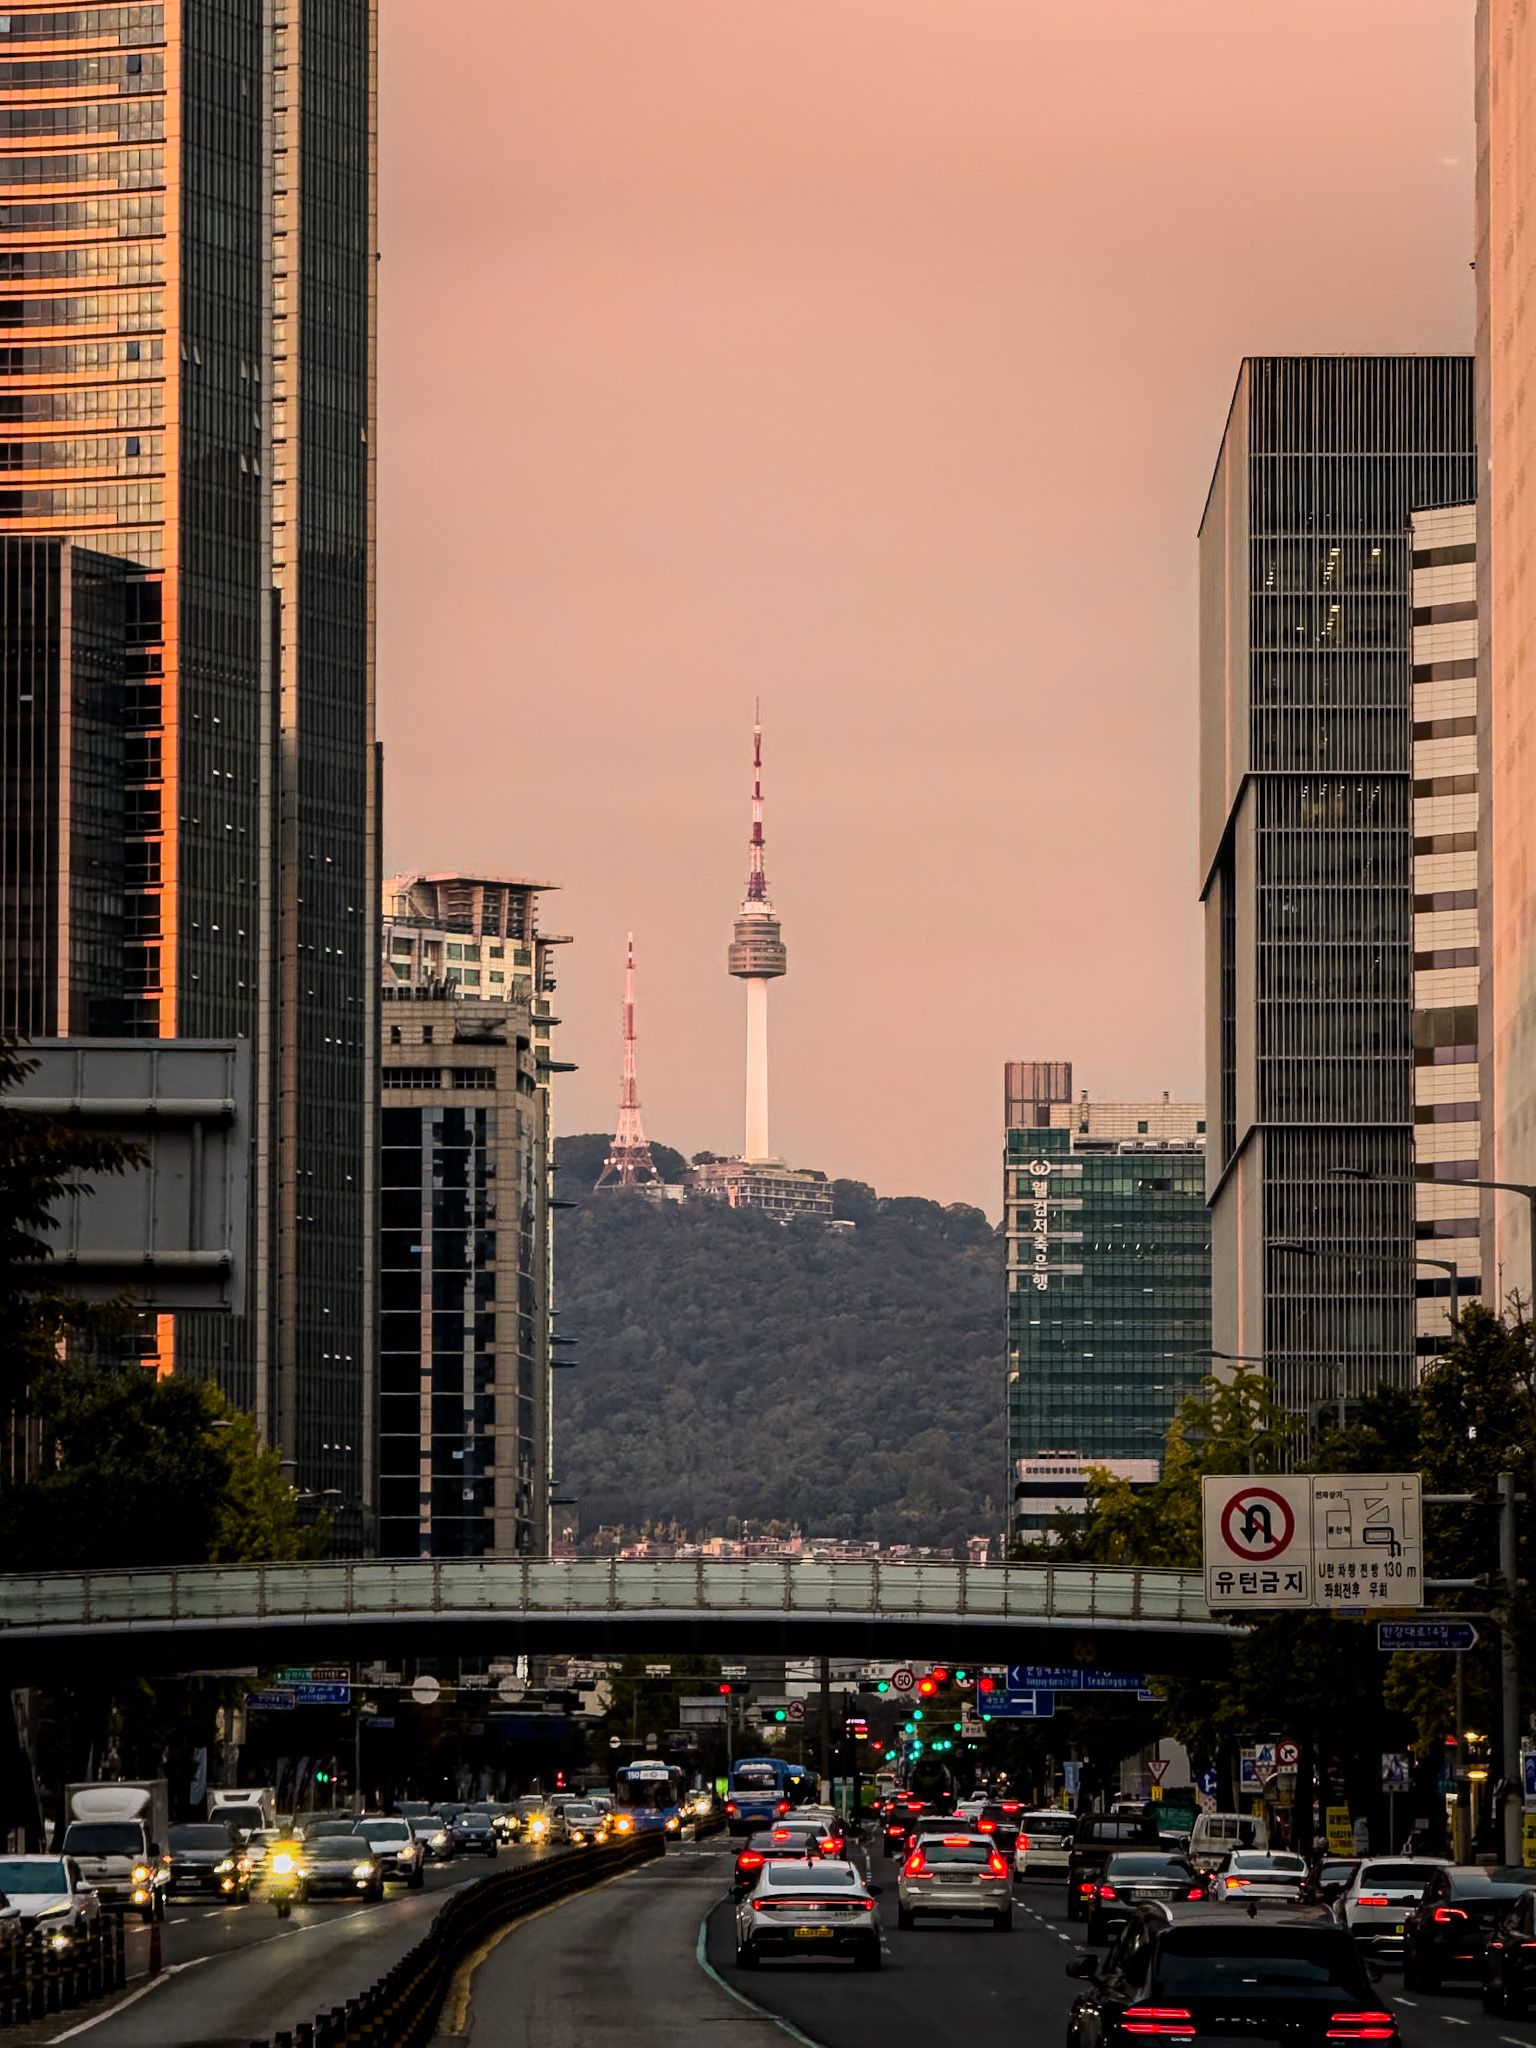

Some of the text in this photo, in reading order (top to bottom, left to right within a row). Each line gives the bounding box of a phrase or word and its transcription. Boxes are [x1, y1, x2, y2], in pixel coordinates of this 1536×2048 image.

[1031, 1181, 1048, 1291] 웰컴저축은행
[1318, 1563, 1334, 1578] U턴
[1338, 1562, 1356, 1578] 차량
[1360, 1562, 1379, 1578] 전방
[1384, 1561, 1402, 1577] 130
[1215, 1571, 1303, 1594] 유턴금지
[898, 1674, 911, 1686] 50
